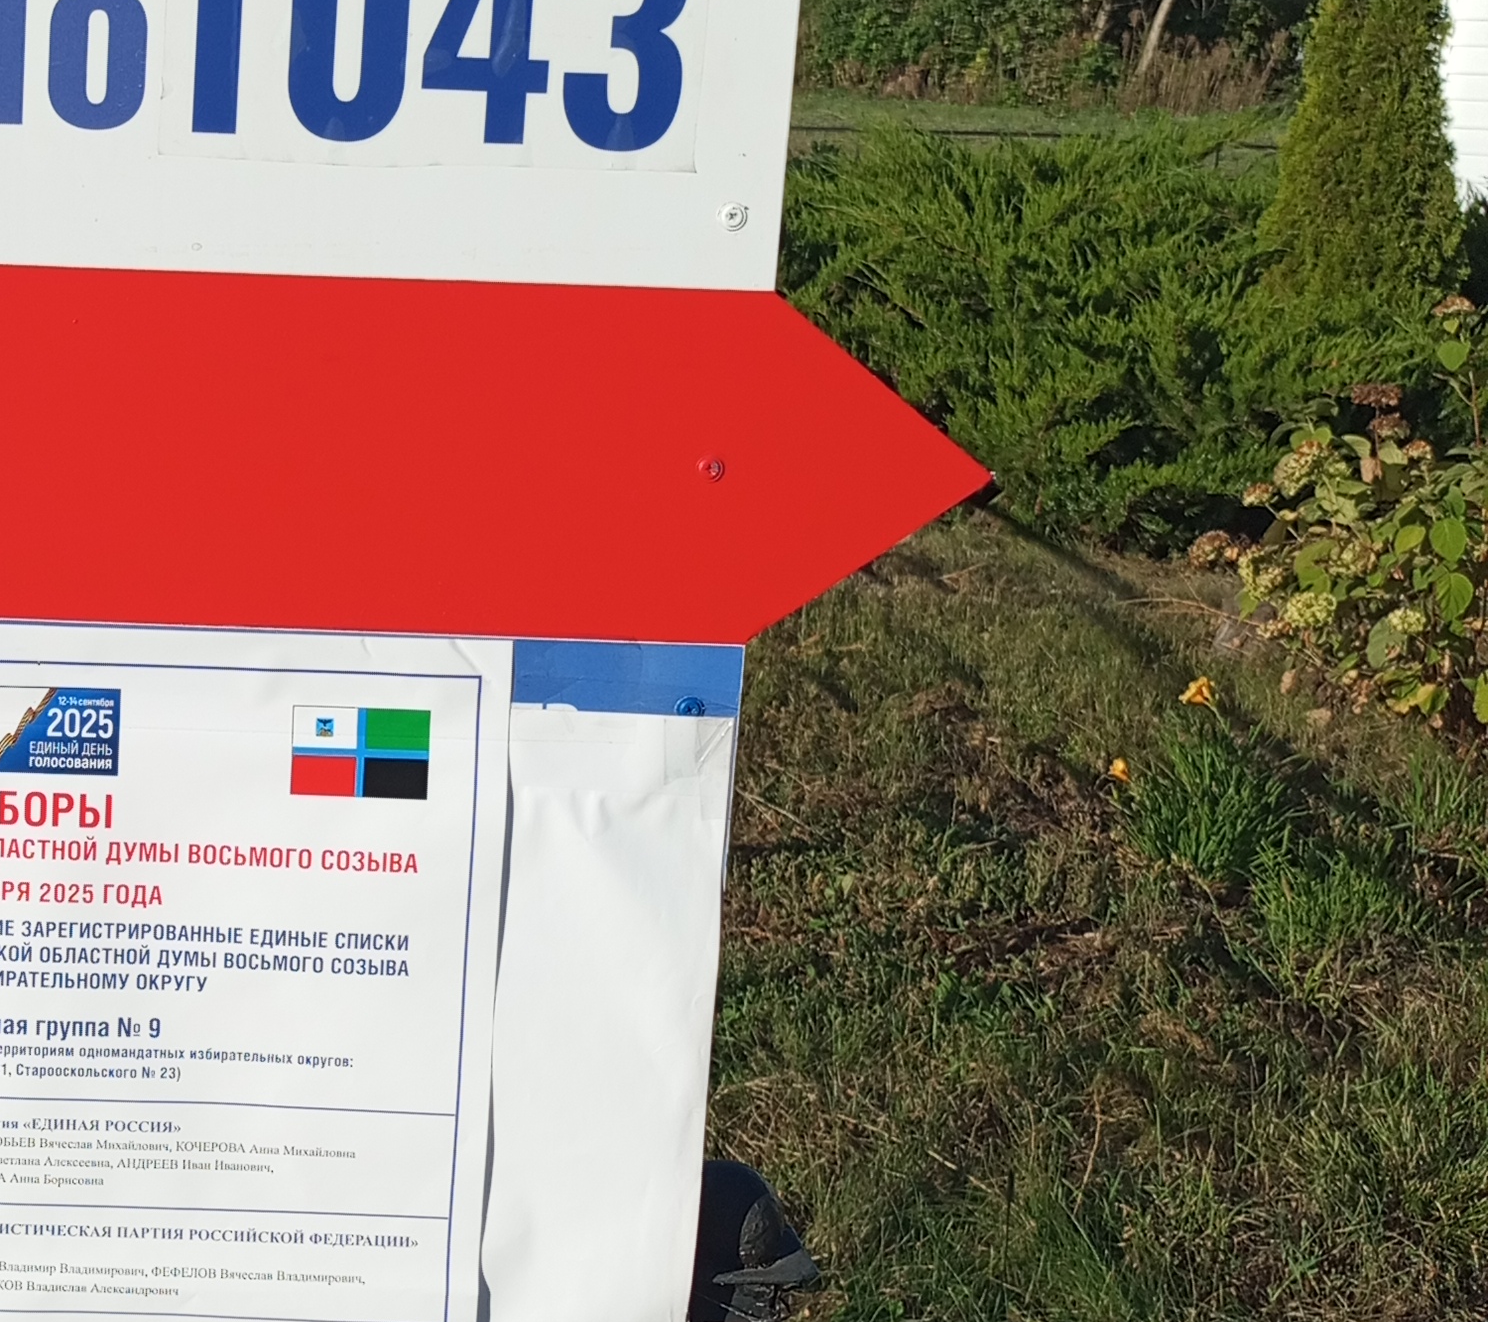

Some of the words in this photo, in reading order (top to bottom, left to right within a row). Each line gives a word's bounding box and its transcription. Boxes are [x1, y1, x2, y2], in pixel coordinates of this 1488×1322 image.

[47, 708, 114, 739] 2025
[29, 740, 79, 755] ЕДИНЫЙ
[81, 743, 113, 756] ДЕНЬ
[106, 842, 179, 865] ДУМЫ
[189, 844, 312, 869] ВОСЬМОГО
[321, 850, 418, 873] СОЗЫВА
[40, 883, 94, 903] 2025
[104, 884, 162, 908] ГОДА
[22, 921, 243, 944] ЗАРЕГИСТРИРОВАННЫЕ
[250, 929, 328, 948] ЕДИНЫЕ
[335, 933, 408, 950] СПИСКИ
[40, 947, 150, 965] ОБЛАСТНОЙ
[157, 950, 216, 968] ДУМЫ
[224, 953, 323, 973] ВОСЬМОГО
[331, 958, 408, 976] СОЗЫВА
[137, 974, 207, 992] ОКРУГУ
[36, 1020, 109, 1039] группа
[118, 1017, 140, 1037] №
[149, 1018, 160, 1038] 9
[79, 1048, 184, 1060] одномандатных
[190, 1048, 292, 1063] избирательных
[298, 1055, 353, 1068] округов:
[16, 1064, 137, 1078] Старооскольского
[142, 1066, 155, 1078] №
[160, 1067, 181, 1081] 23)
[23, 1118, 99, 1131] «ЕДИНАЯ
[106, 1120, 181, 1132] РОССИЯ»
[118, 1227, 183, 1239] ПАРТИЯ
[190, 1228, 304, 1243] РОССИЙСКОЙ
[309, 1233, 418, 1247] ФЕДЕРАЦИИ»
